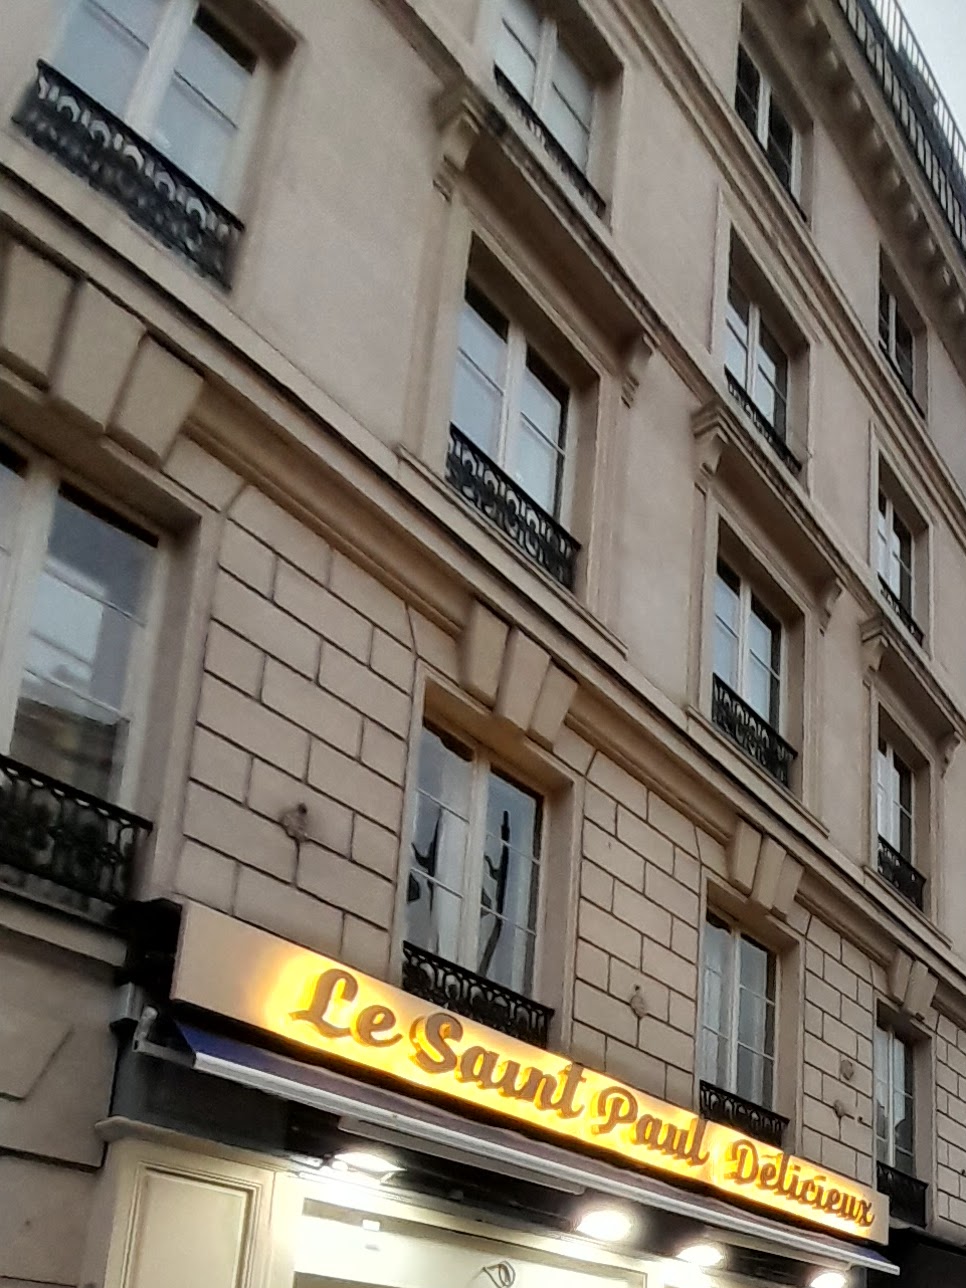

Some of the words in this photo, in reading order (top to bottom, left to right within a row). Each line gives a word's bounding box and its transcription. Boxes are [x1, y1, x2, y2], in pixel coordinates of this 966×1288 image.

[290, 968, 403, 1048] Le
[409, 1012, 587, 1120] Saint
[591, 1086, 711, 1167] Paul
